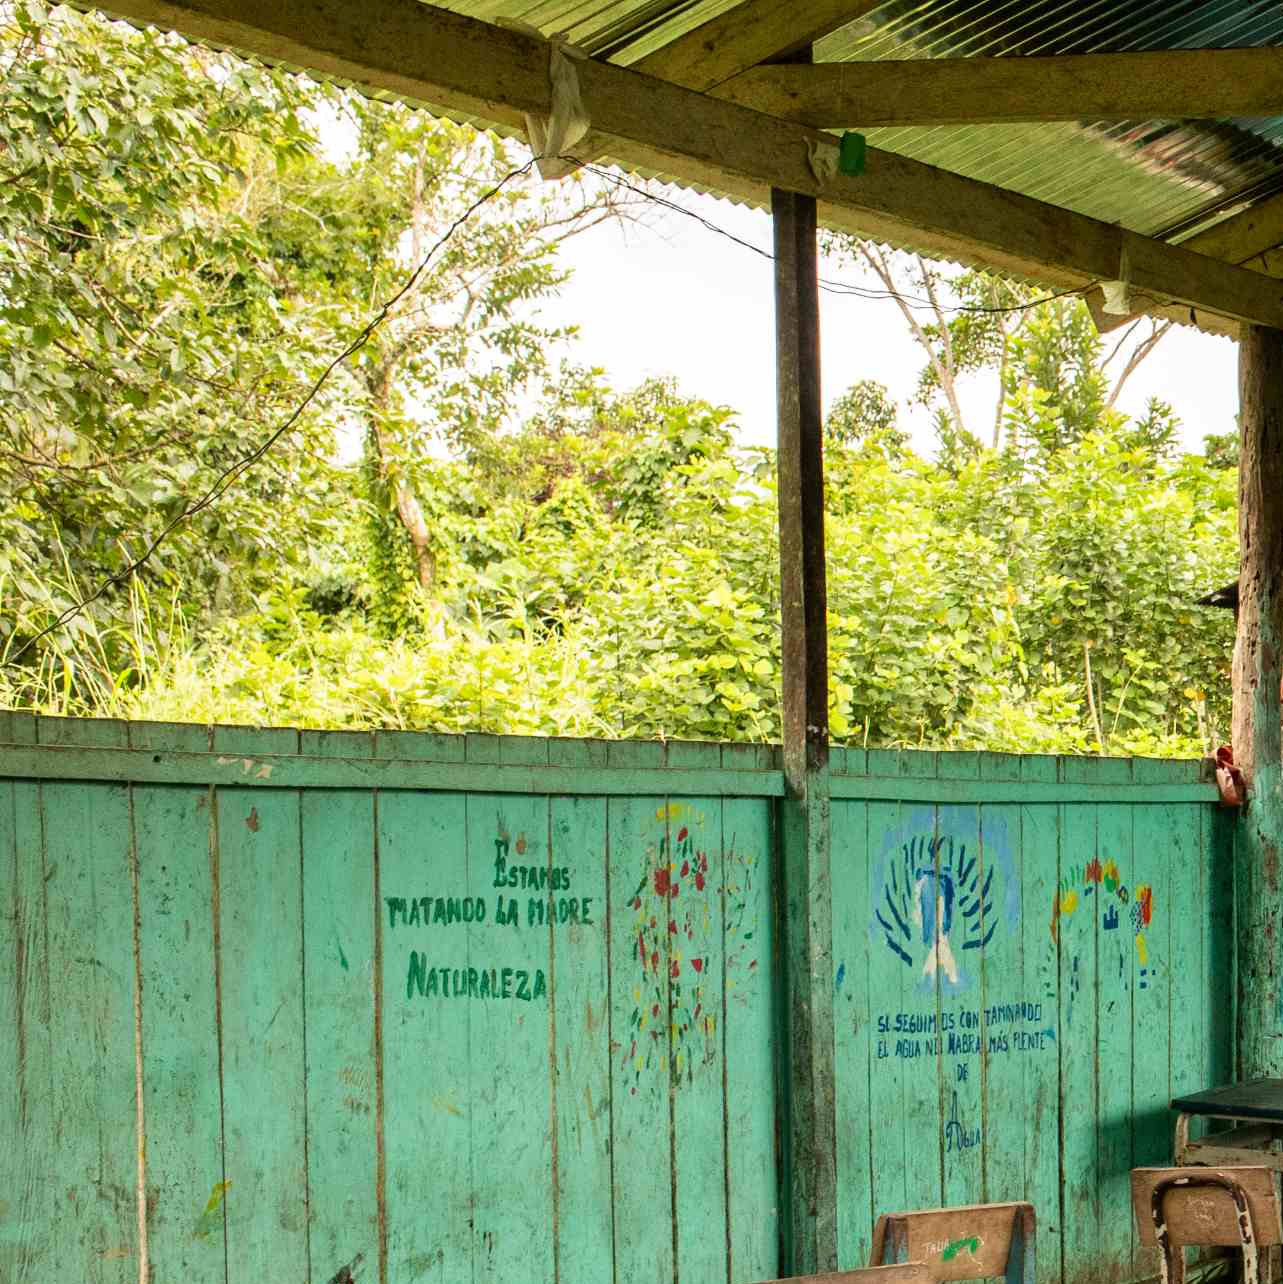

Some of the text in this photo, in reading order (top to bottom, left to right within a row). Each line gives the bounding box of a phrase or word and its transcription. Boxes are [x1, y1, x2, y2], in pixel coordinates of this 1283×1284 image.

[383, 894, 594, 928] MATANDO LA MADRE
[407, 950, 547, 1001] NATURALEZA
[878, 1015, 890, 1033] SI
[878, 1039, 889, 1059] EL
[895, 1038, 921, 1059] AGUA
[957, 1062, 969, 1082] DE
